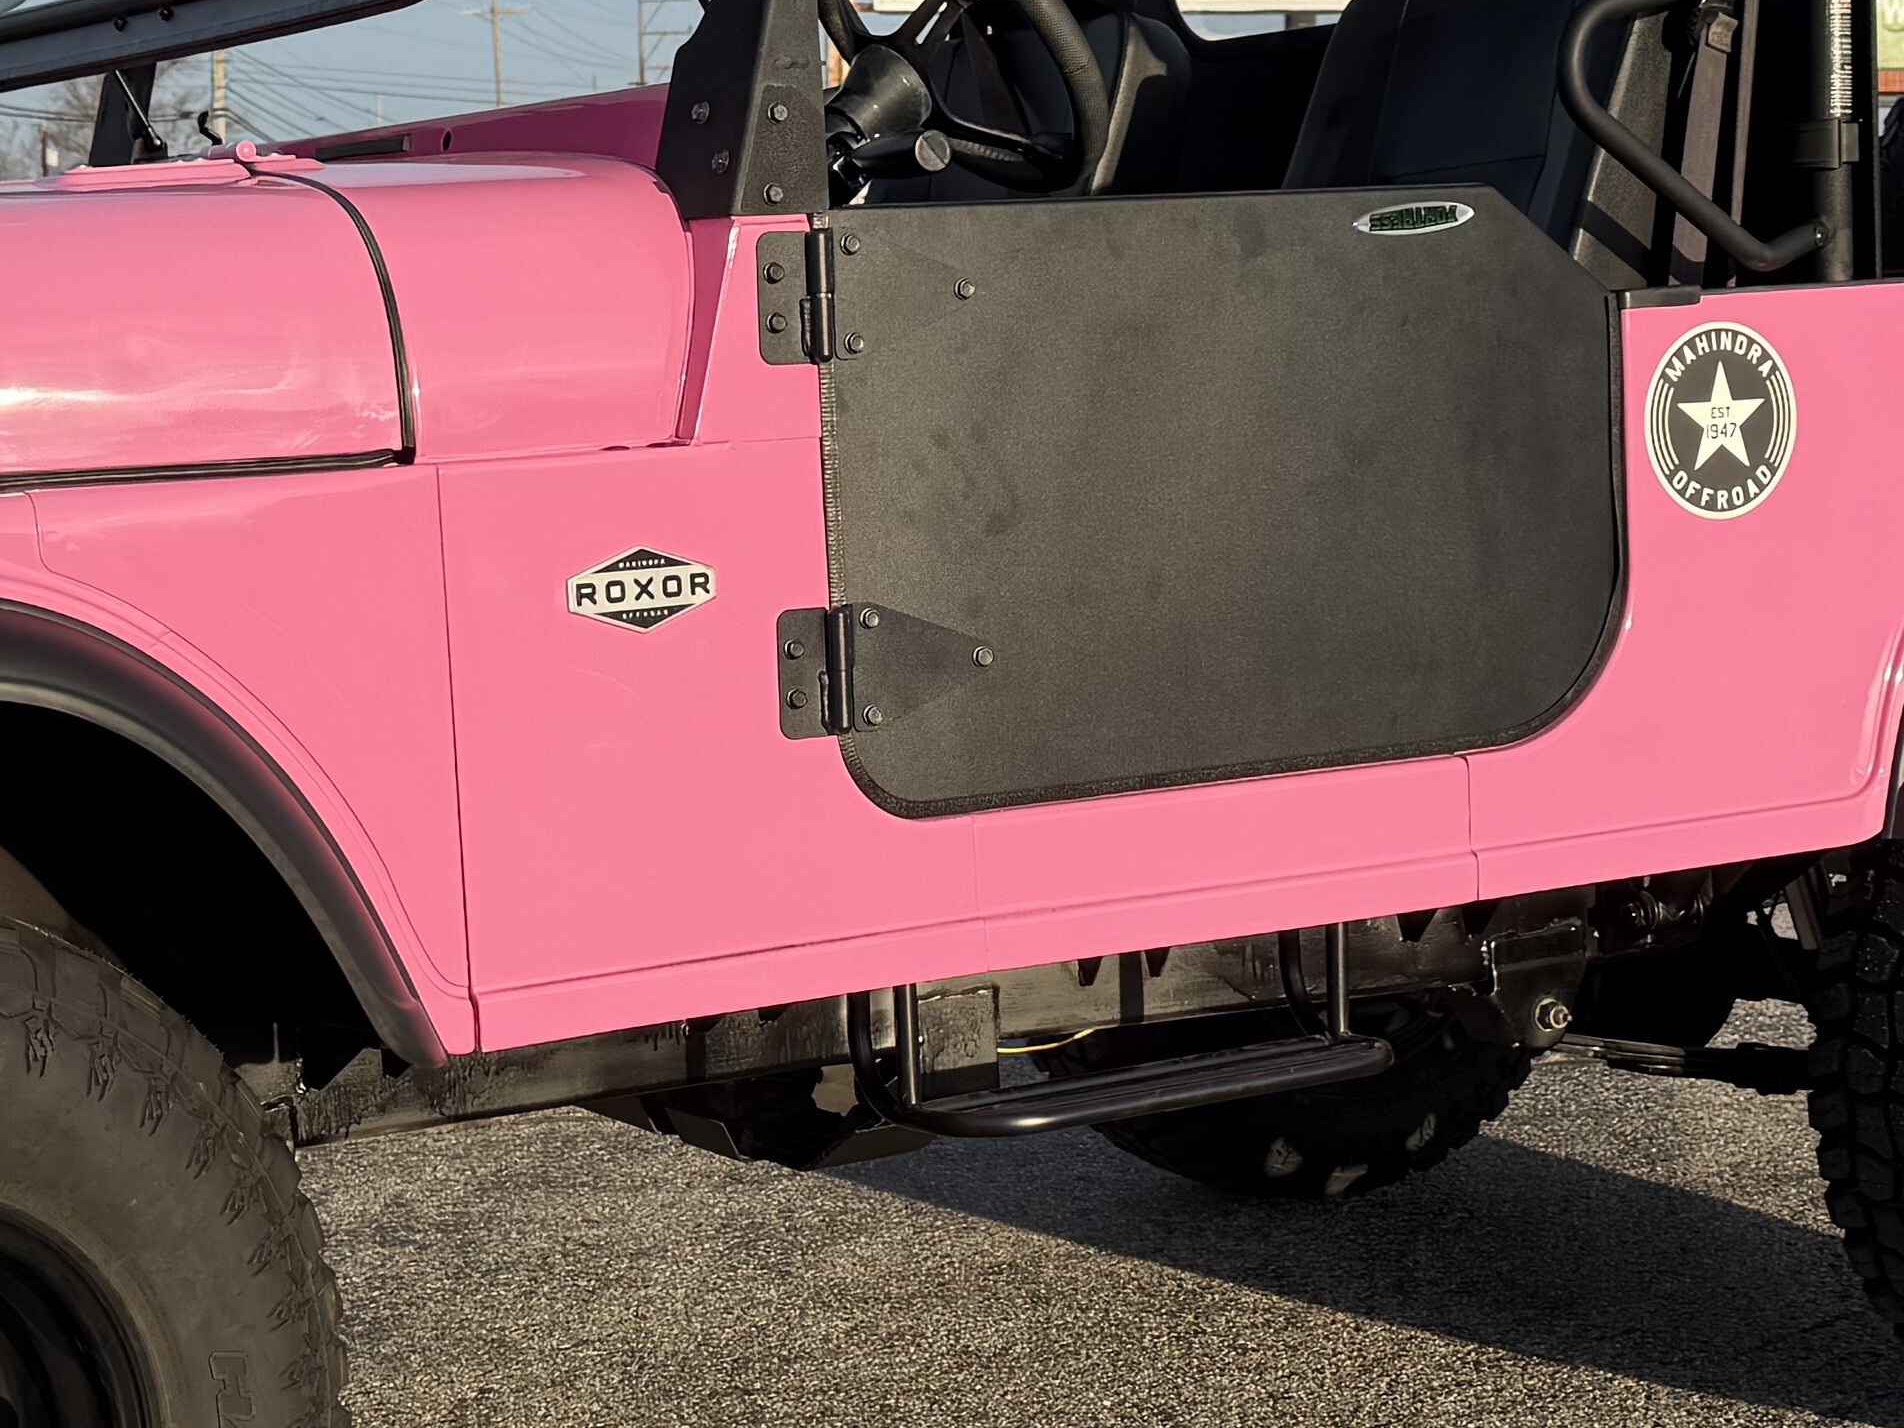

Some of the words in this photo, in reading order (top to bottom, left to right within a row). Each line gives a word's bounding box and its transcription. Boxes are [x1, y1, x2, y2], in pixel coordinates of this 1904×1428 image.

[1664, 330, 1774, 382] MAHINDRA
[1706, 422, 1738, 440] 1947
[1671, 463, 1773, 510] OFFROAD
[575, 572, 711, 607] ROXOR
